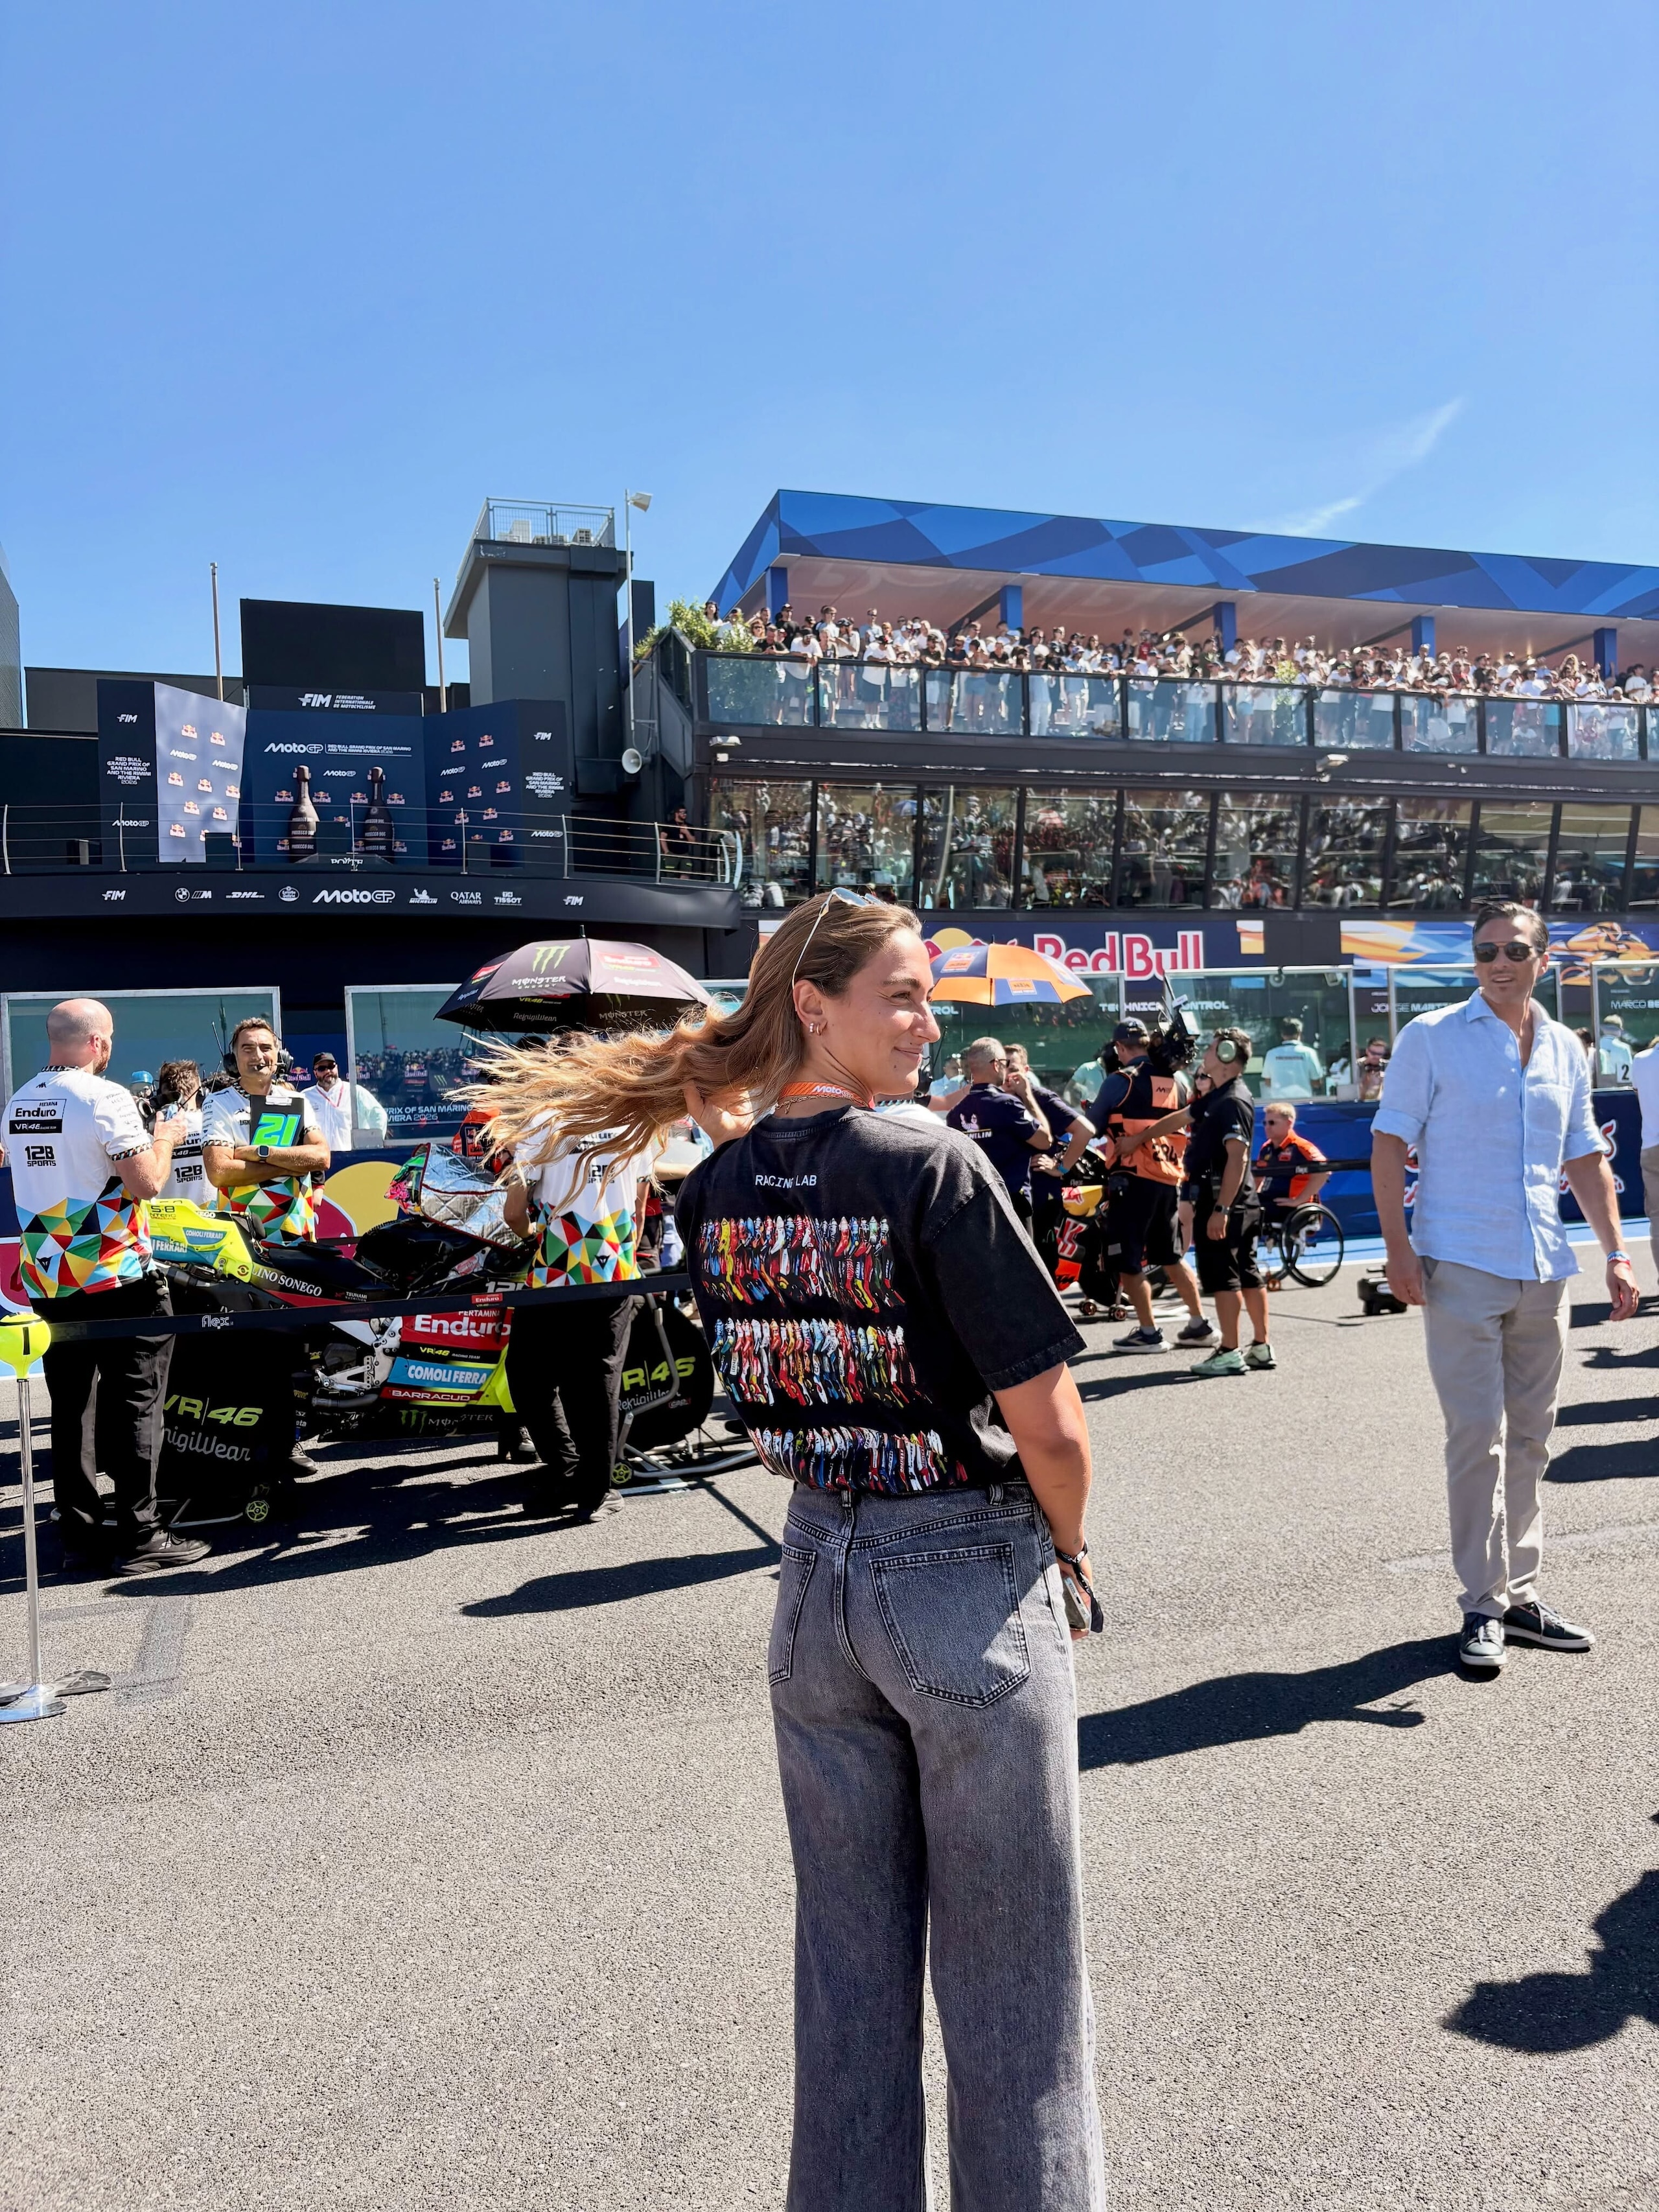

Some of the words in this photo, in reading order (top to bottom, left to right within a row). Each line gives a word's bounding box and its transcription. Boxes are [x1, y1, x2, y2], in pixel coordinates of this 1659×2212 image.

[298, 693, 332, 708] FIM
[117, 714, 137, 723] FIM
[534, 732, 552, 740] FIM
[264, 743, 323, 754] MotoGP
[102, 891, 126, 901] FIM
[312, 889, 395, 903] MotoGP
[450, 891, 481, 901] QATAR
[563, 896, 584, 906] FIM
[1034, 931, 1120, 973] Red
[1122, 930, 1204, 982] Bull
[811, 1085, 854, 1099] MotoGP
[16, 1108, 56, 1117] Enduro
[251, 1113, 301, 1147] 21
[796, 1174, 817, 1186] LAB
[203, 1231, 224, 1239] FERRARI
[278, 1275, 323, 1297] SONEGO
[414, 1314, 512, 1337] Enduro
[407, 1364, 451, 1382] COMOLI
[391, 1390, 470, 1402] BARRACUD
